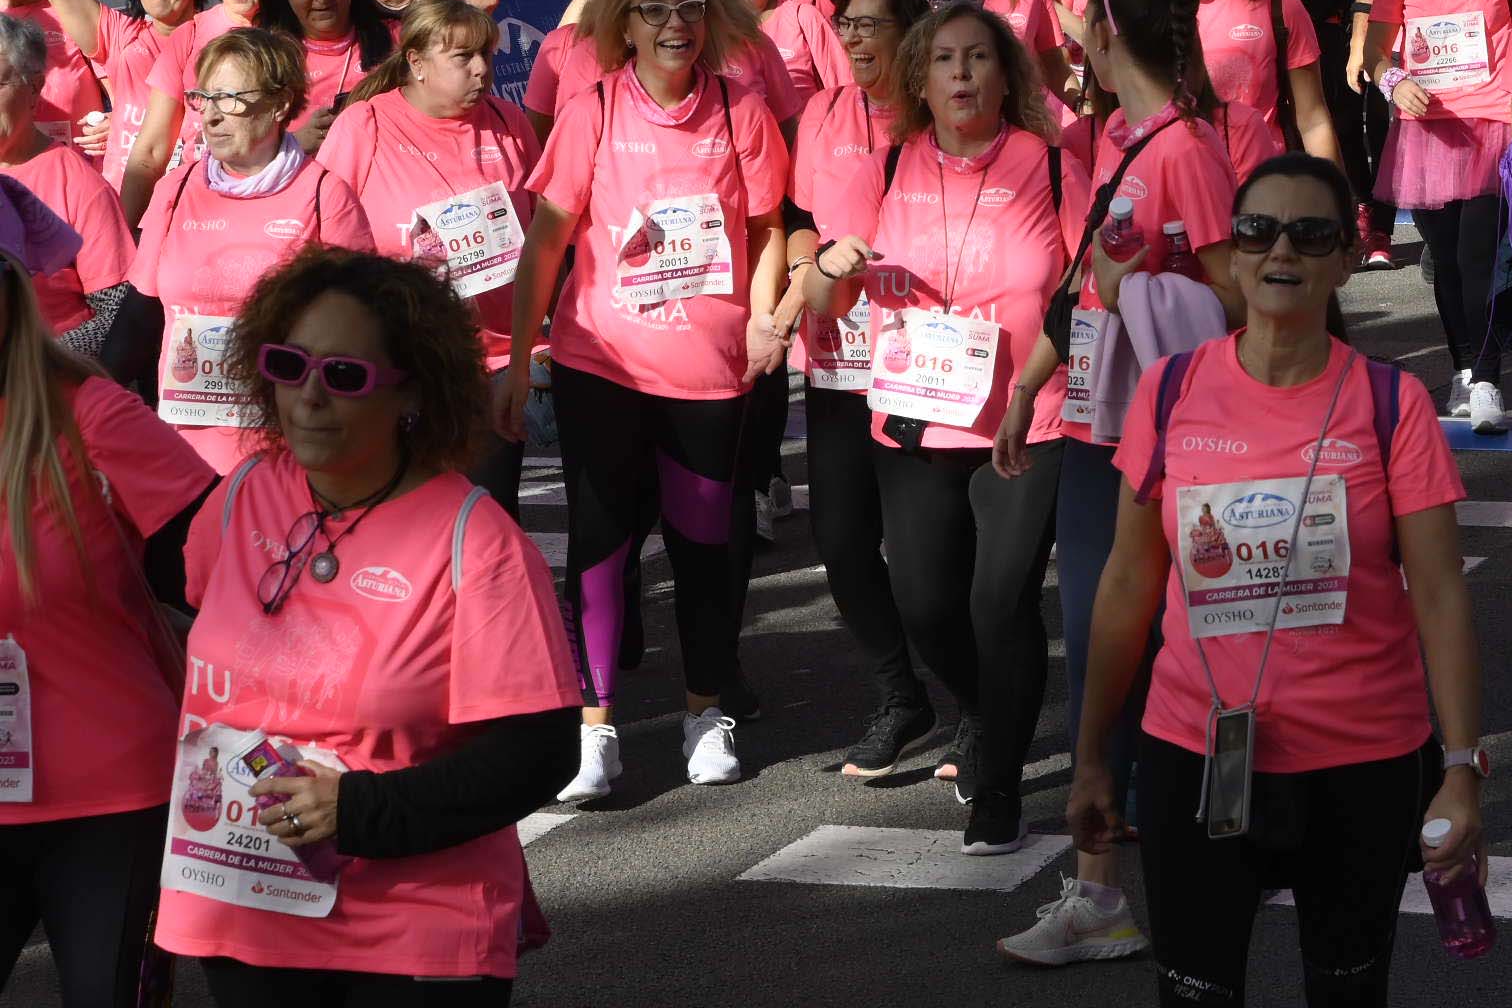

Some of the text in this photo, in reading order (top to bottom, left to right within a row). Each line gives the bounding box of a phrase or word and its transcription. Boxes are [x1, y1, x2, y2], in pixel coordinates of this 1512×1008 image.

[1433, 43, 1459, 56] 016
[449, 230, 485, 253] 016
[654, 237, 692, 255] 016
[457, 249, 485, 265] 26799
[659, 256, 689, 268] 20013
[632, 272, 662, 284] CARRERA
[877, 270, 911, 296] TU
[845, 330, 867, 345] 01
[850, 349, 870, 358] 2001
[914, 353, 953, 373] 016
[1068, 355, 1091, 371] 16
[821, 373, 856, 384] OYSHO
[915, 373, 945, 387] 20011
[174, 392, 206, 402] CARRERA
[170, 406, 206, 417] OYSHO
[1182, 436, 1248, 455] OYSHO
[1228, 507, 1291, 523] ASTURIANA
[1235, 539, 1290, 562] 016
[354, 573, 408, 600] ASTURIANA
[1206, 589, 1251, 601] CARRERA
[1252, 587, 1265, 596] DE
[1266, 586, 1280, 595] LA
[1281, 583, 1314, 593] MUJER
[1295, 600, 1344, 614] Santander
[1204, 609, 1255, 625] OYSHO
[190, 655, 231, 704] TU
[226, 799, 262, 827] 01
[226, 831, 271, 853] 24201
[187, 844, 311, 877] CARRERA DE LA MUJER 20
[181, 865, 226, 888] OYSHO
[266, 884, 323, 904] Santander
